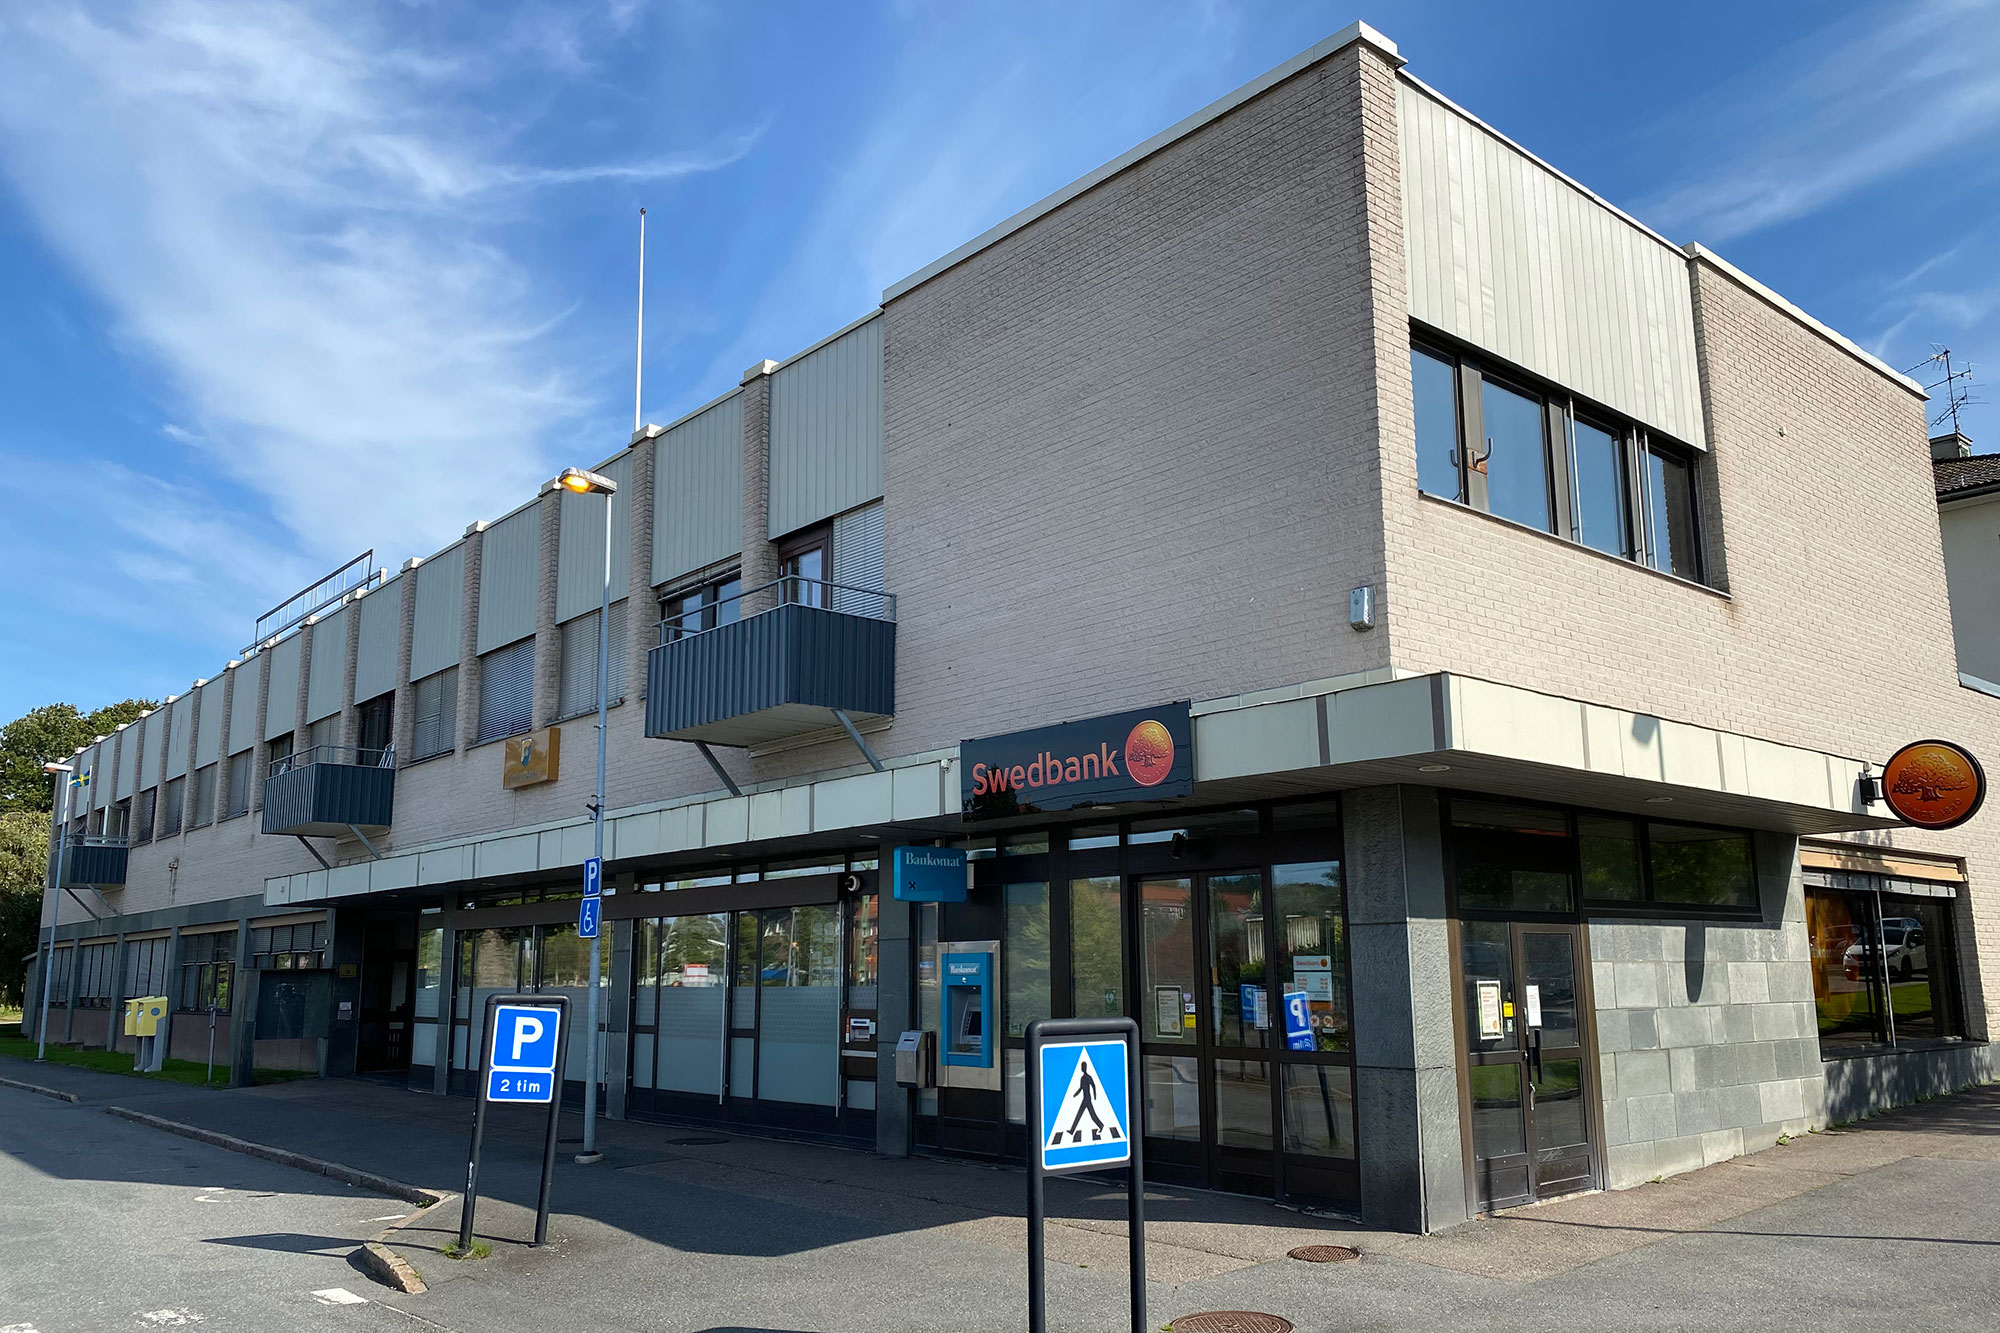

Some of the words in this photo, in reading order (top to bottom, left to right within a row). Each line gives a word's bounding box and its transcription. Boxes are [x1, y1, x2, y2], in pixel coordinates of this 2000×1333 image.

[972, 742, 1119, 796] Swedbank
[905, 852, 960, 867] Bankomat
[587, 861, 598, 892] P
[512, 1016, 544, 1060] P
[500, 1079, 511, 1092] 2
[516, 1079, 541, 1093] tim
